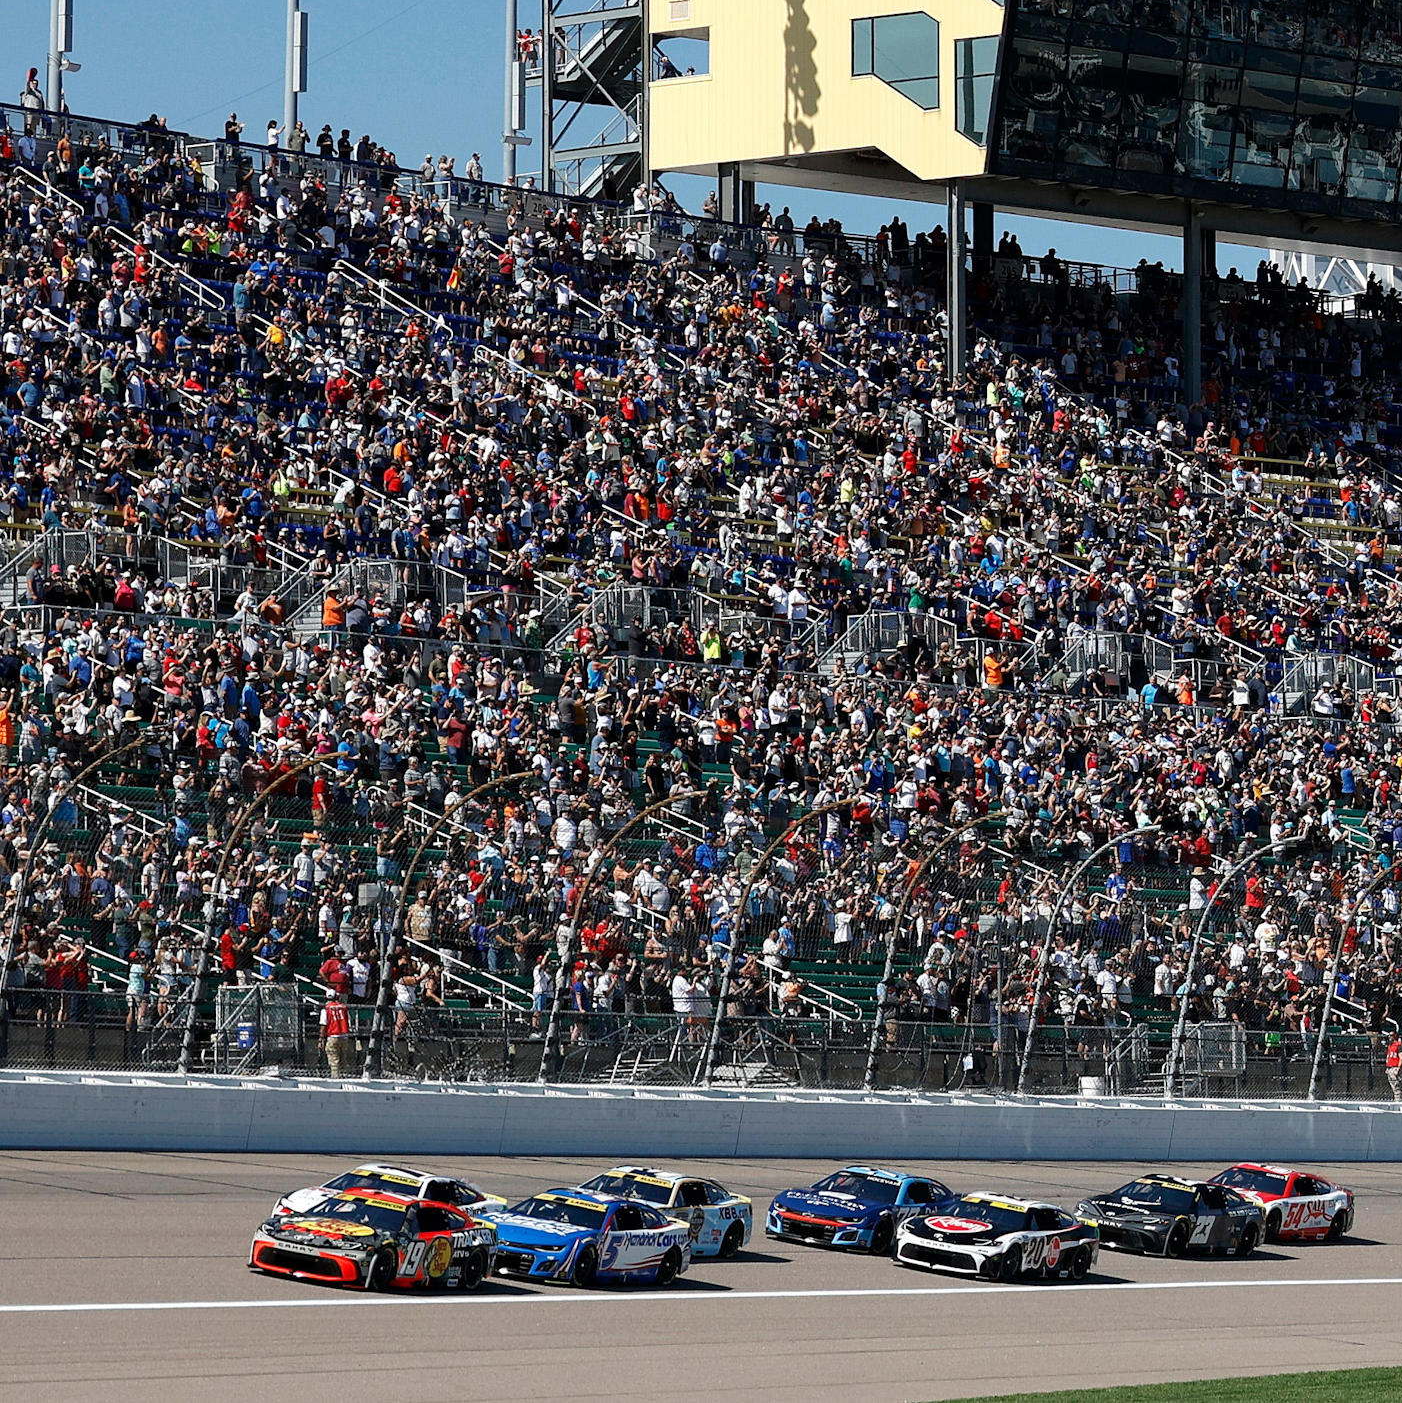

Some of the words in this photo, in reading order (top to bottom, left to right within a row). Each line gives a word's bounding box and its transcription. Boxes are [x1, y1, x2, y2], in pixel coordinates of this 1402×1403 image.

[570, 1199, 600, 1209] LARSON
[928, 1216, 985, 1233] Rheem
[1283, 1203, 1305, 1229] 54
[278, 1242, 315, 1253] CAMRY
[451, 1228, 494, 1249] TRACKER
[396, 1240, 427, 1276] 19
[601, 1234, 625, 1269] 5
[1023, 1236, 1047, 1269] 20
